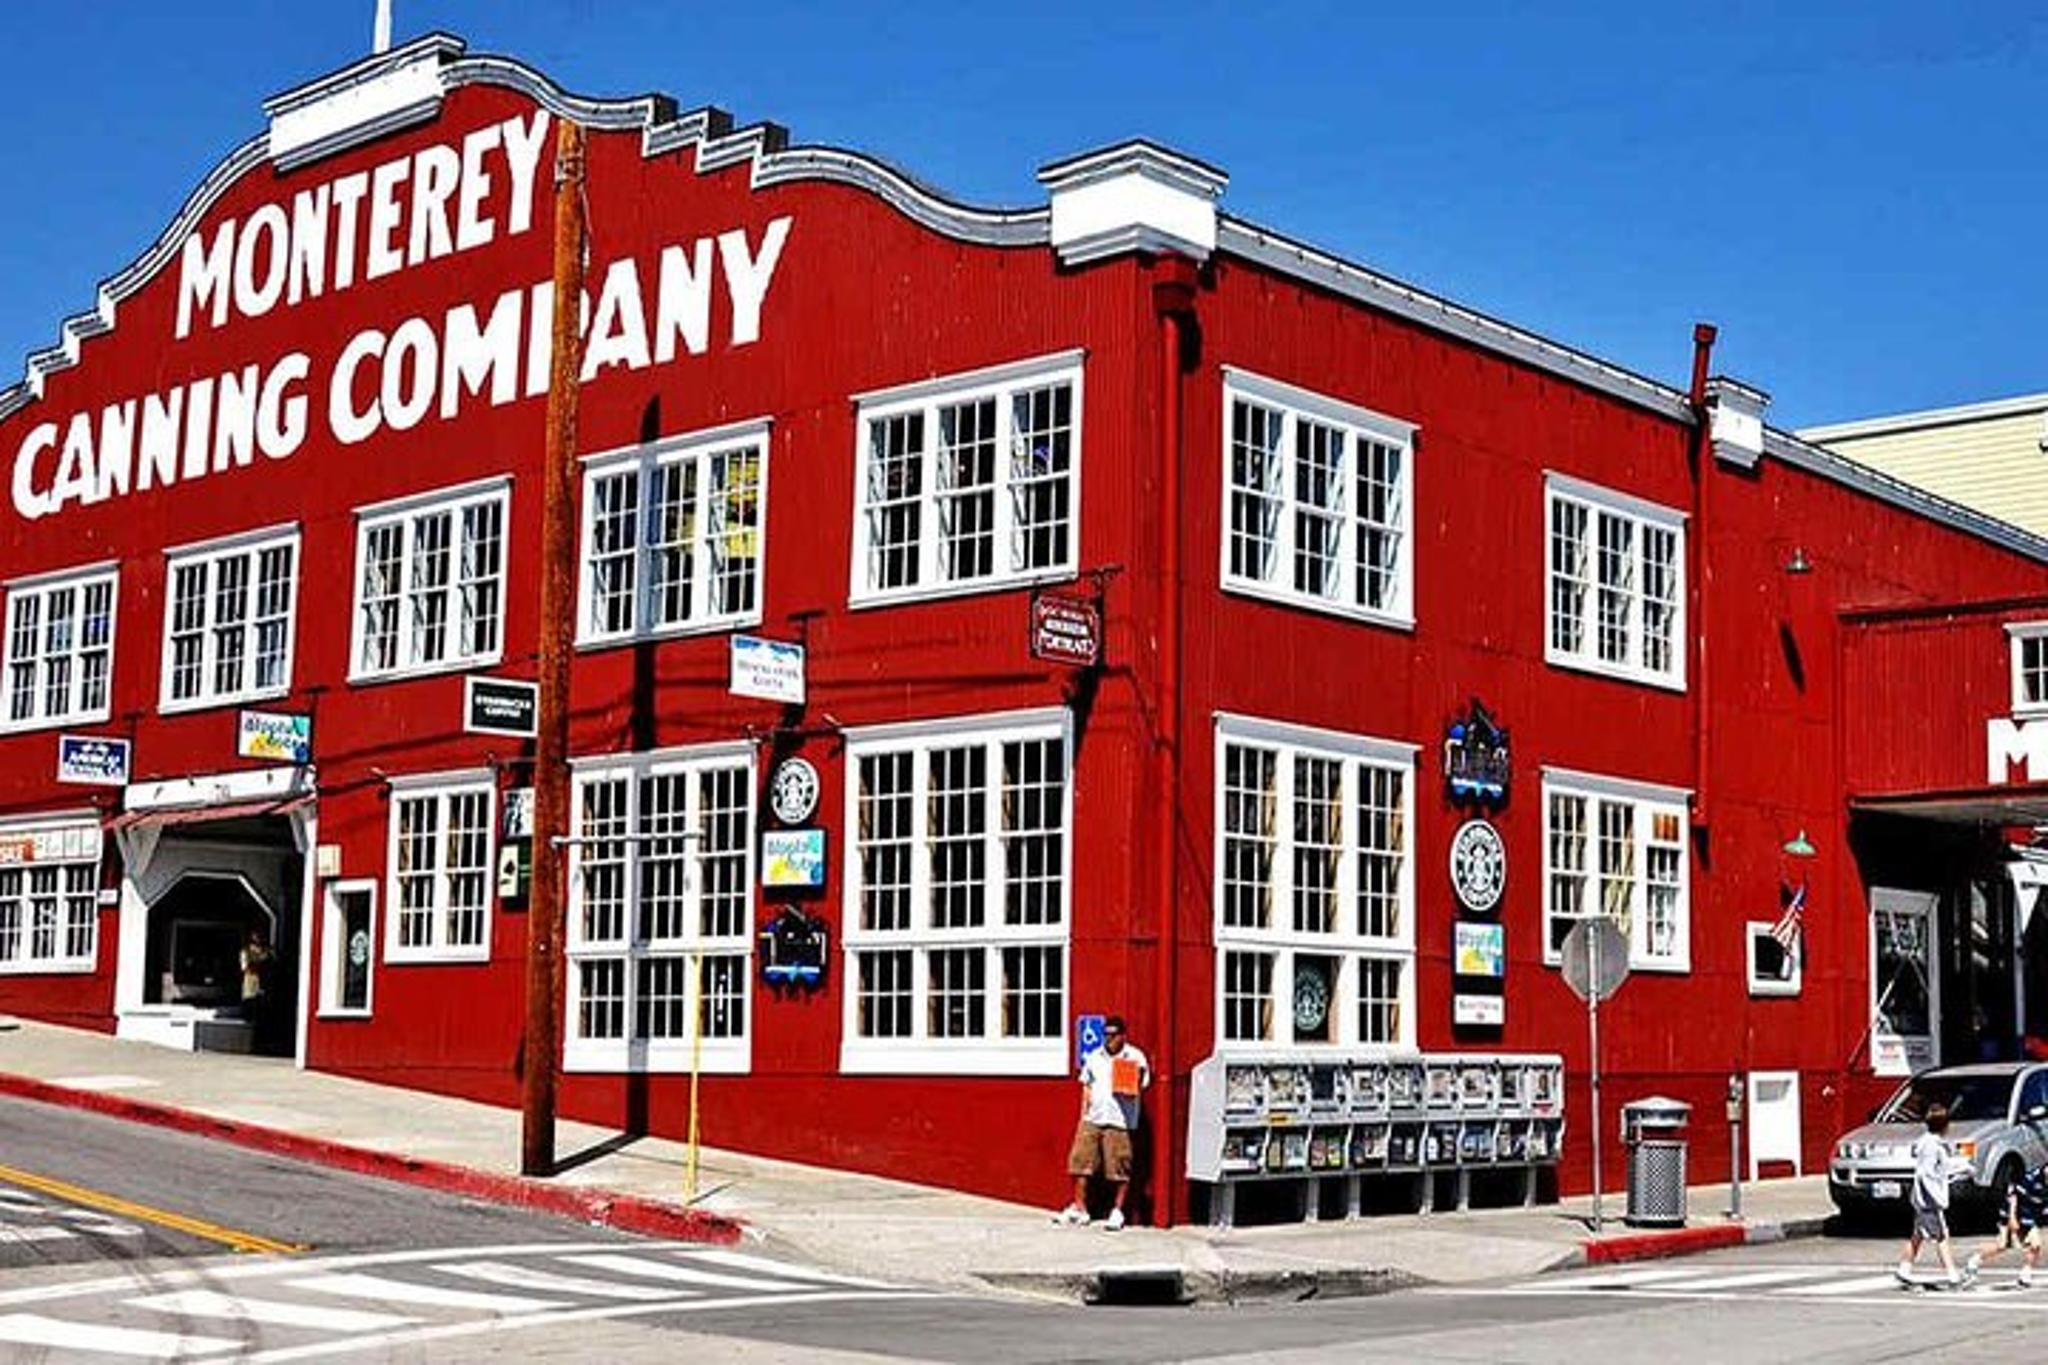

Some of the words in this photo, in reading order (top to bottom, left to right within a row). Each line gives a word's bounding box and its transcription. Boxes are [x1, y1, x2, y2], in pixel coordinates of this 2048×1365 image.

[175, 109, 550, 339] MONTEREY
[12, 353, 310, 519] CANNING
[329, 216, 792, 444] COMPANY
